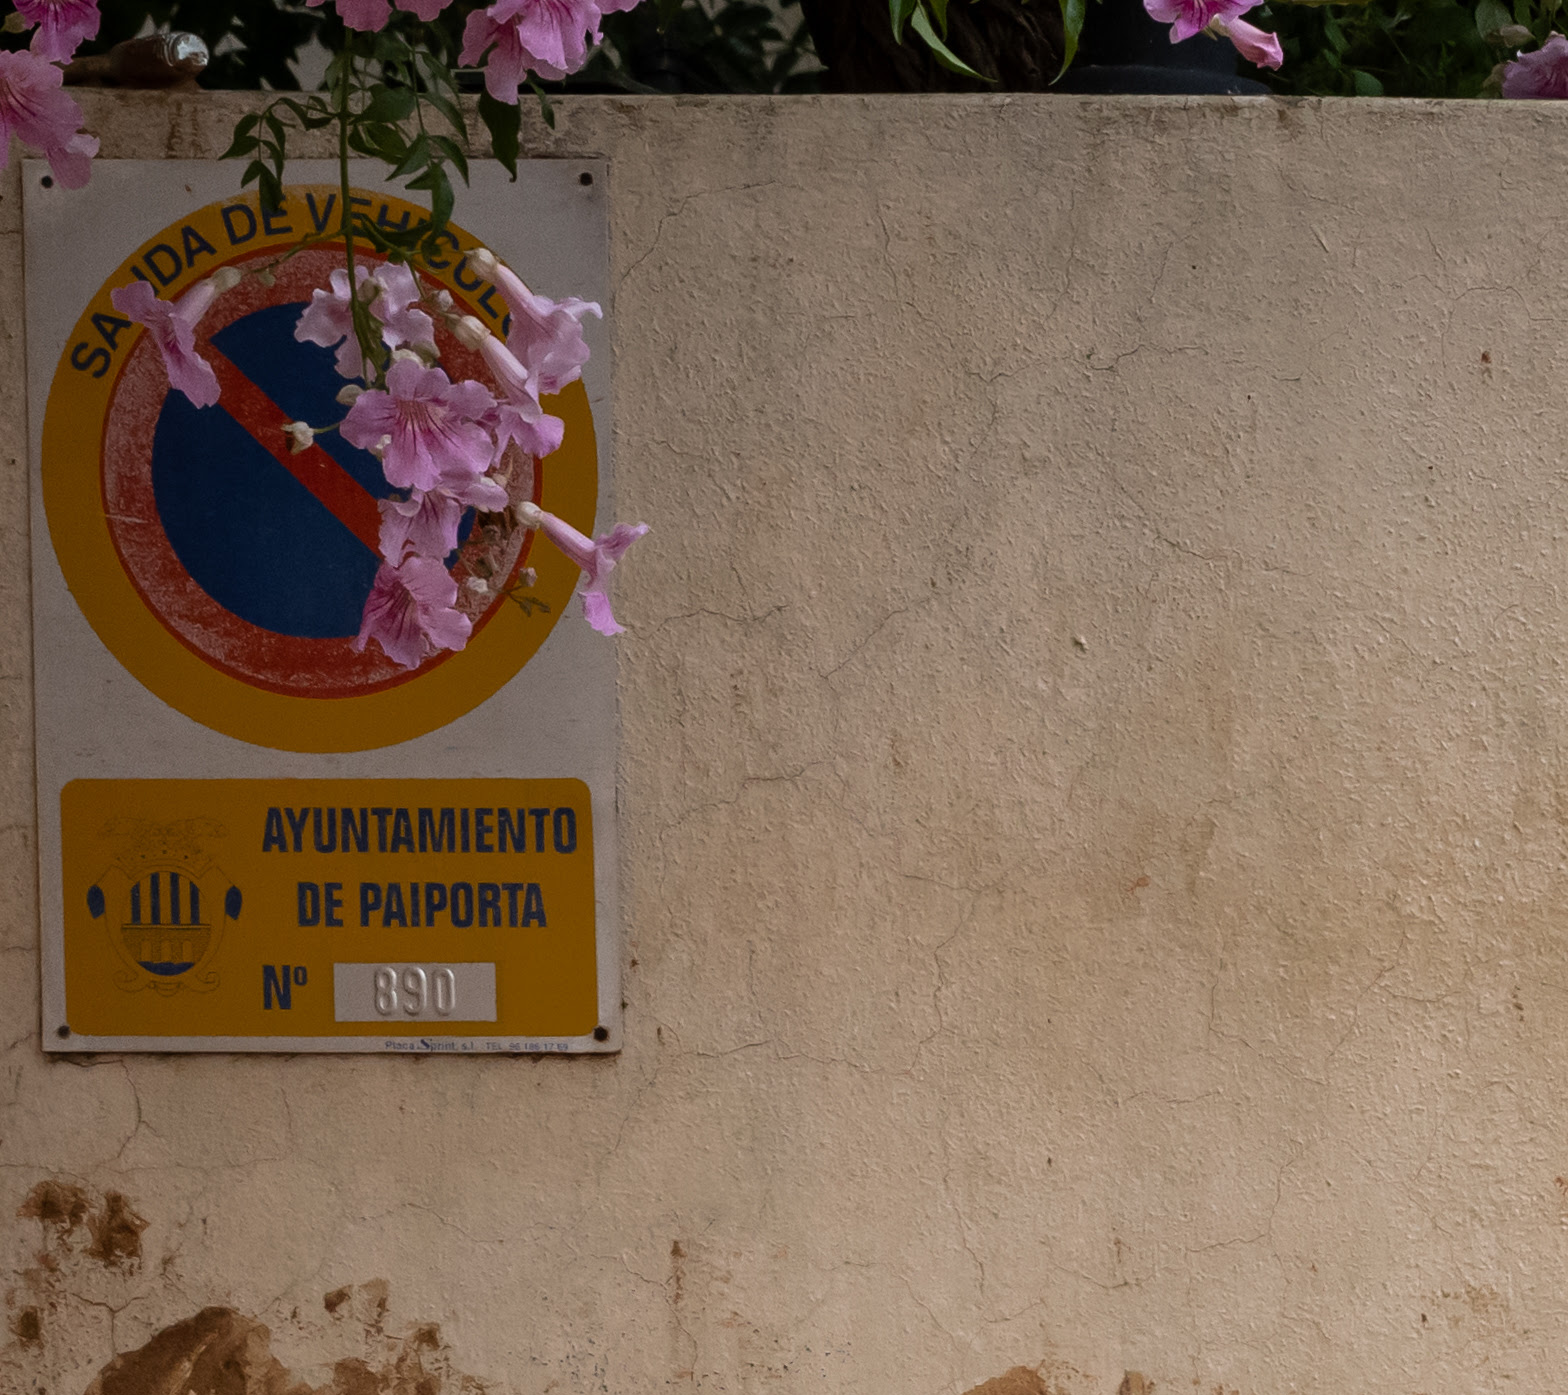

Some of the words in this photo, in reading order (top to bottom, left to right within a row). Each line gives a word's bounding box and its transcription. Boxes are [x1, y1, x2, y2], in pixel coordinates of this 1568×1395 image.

[70, 225, 218, 379] SAIDA
[262, 806, 578, 854] AYUNTAMIENTO
[297, 881, 344, 928] DE
[359, 881, 548, 928] PAIPORTA
[262, 964, 308, 1010] Nº
[373, 965, 457, 1017] 890
